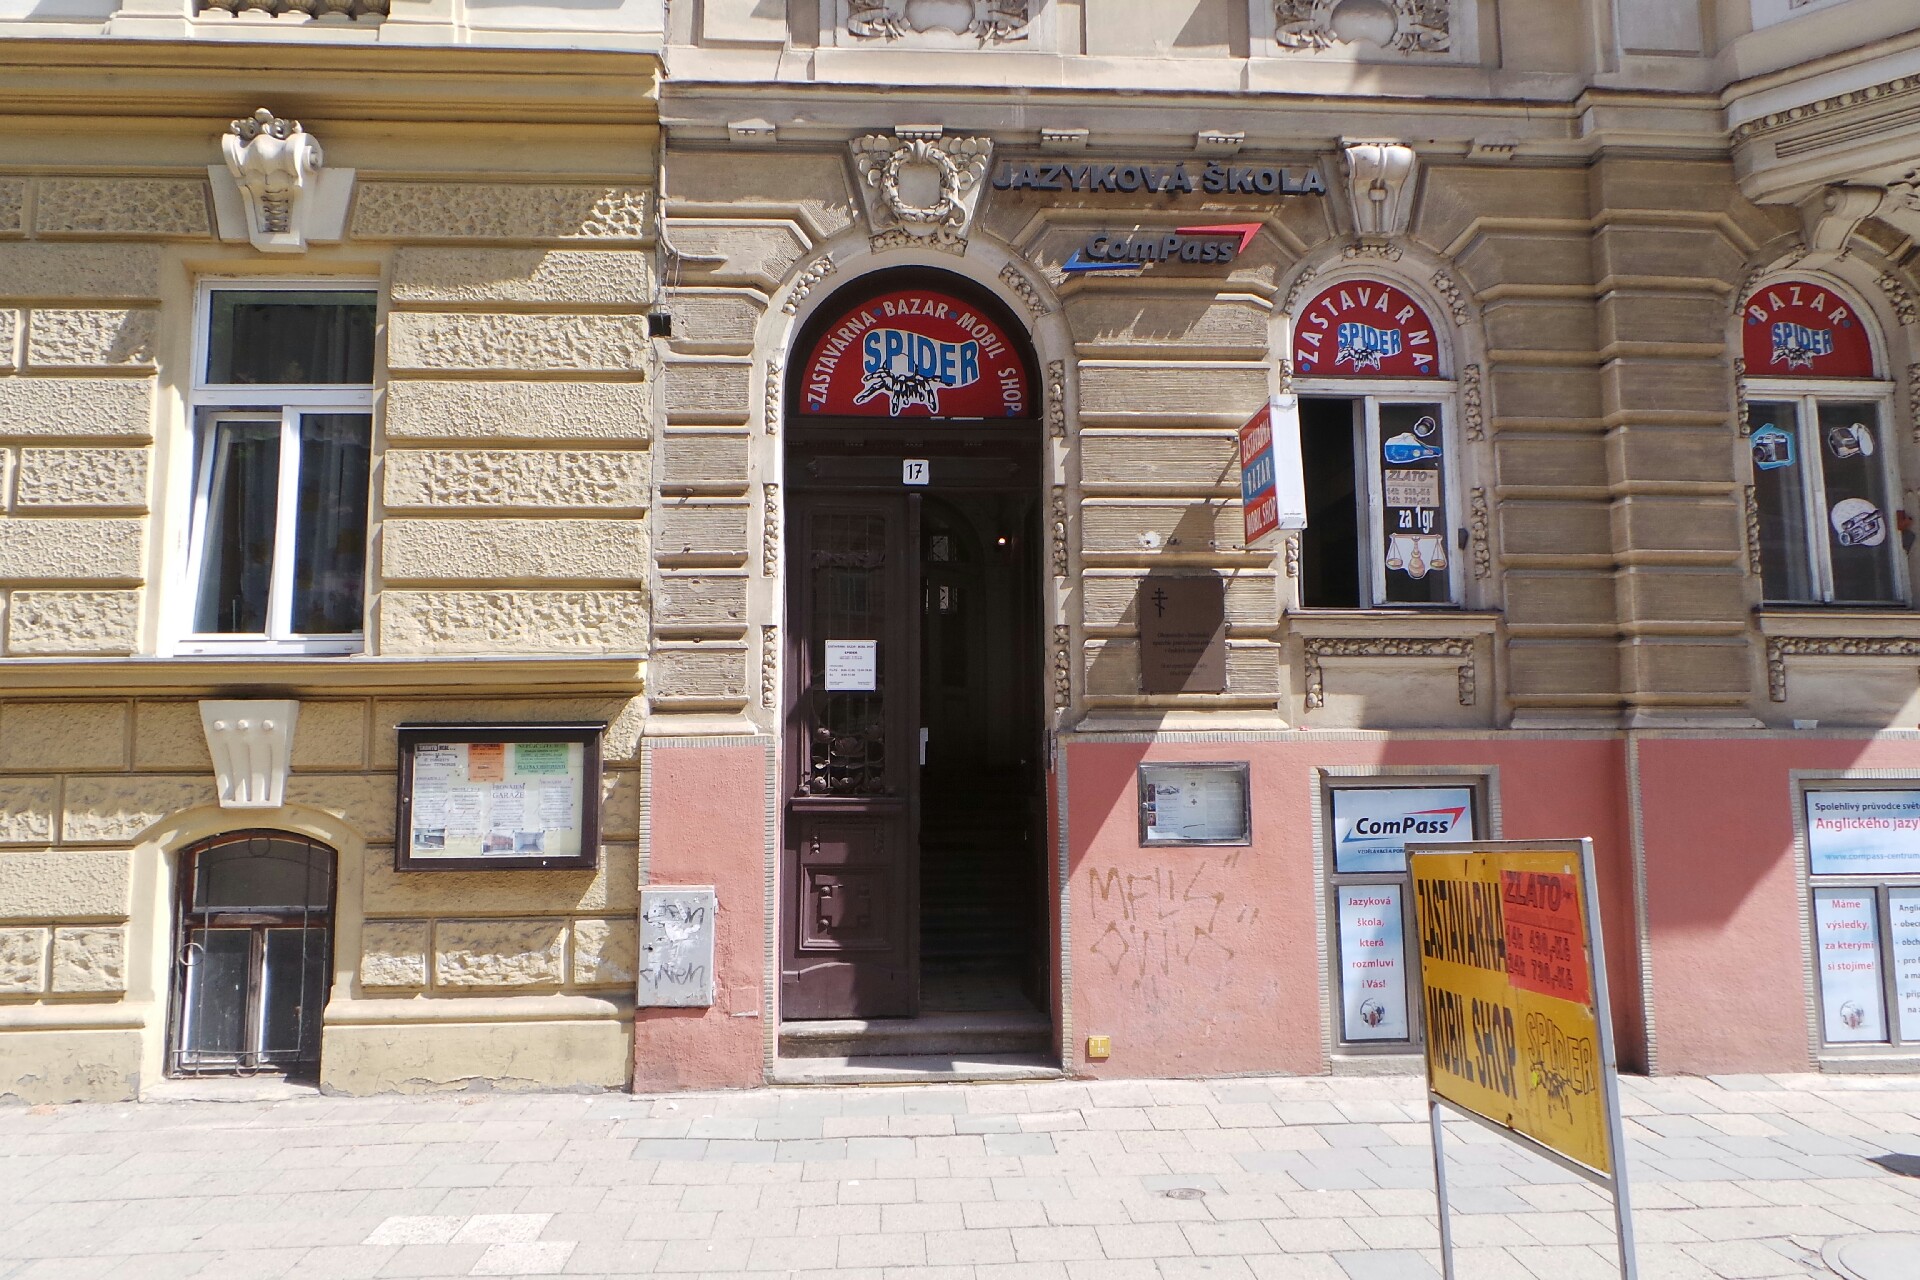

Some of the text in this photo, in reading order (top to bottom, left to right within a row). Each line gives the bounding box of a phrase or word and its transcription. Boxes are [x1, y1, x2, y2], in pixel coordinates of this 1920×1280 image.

[993, 161, 1326, 196] JAZYKOVÁ ŠKOLA
[1086, 233, 1234, 263] ComPass
[883, 298, 949, 320] BAZAR
[1748, 286, 1847, 325] BAZAR
[1298, 287, 1433, 366] ZASTAVÁRNA
[1337, 322, 1401, 355] SPIDER
[1772, 321, 1832, 354] SPIDER
[807, 310, 876, 404] ZASTAVÁRNA
[864, 329, 978, 386] SPIDER
[955, 312, 1022, 412] MOBIL SHOP
[905, 463, 923, 480] 17
[1247, 456, 1271, 496] BAZAR
[1386, 470, 1428, 482] ZLATO
[1246, 496, 1276, 537] MOBIL SHOP
[1399, 510, 1413, 528] za
[1815, 802, 1860, 811] Spolehlivý
[1862, 802, 1901, 811] průvodce
[1356, 817, 1448, 834] ComPass
[1816, 816, 1890, 832] Anglického
[1504, 870, 1561, 912] ZLATO
[1348, 896, 1391, 908] Jazyková
[1832, 899, 1861, 908] Máme
[1357, 917, 1385, 927] škola,
[1826, 920, 1869, 931] výsledky,
[1359, 938, 1384, 947] která
[1837, 940, 1874, 951] kterými
[1352, 958, 1394, 968] rozmluví
[1837, 961, 1875, 972] stojíme!
[1903, 958, 1917, 966] pro
[1366, 979, 1386, 988] Vás!
[1428, 985, 1518, 1100] MOBIL SHOP
[1526, 1011, 1596, 1095] SPIDER
